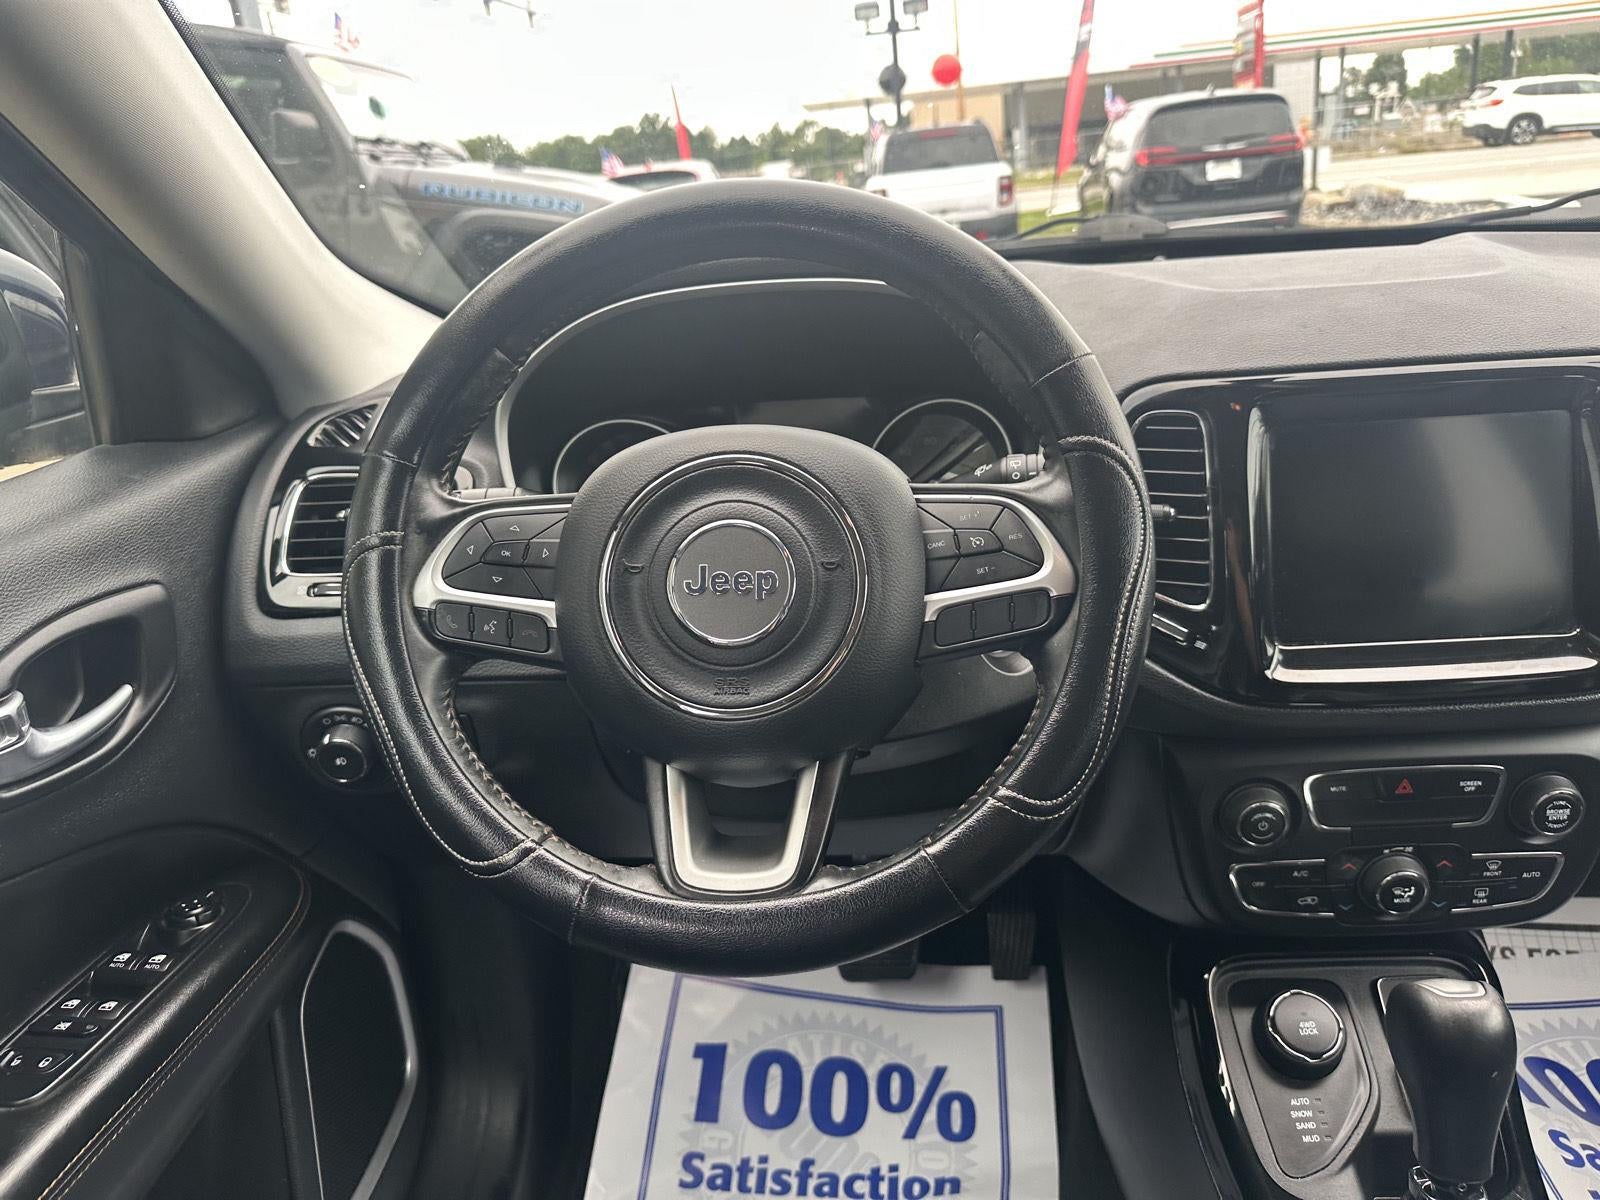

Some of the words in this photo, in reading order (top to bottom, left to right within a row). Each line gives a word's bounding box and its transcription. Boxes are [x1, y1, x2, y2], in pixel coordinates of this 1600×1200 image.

[420, 181, 584, 214] RUBICON
[1008, 533, 1023, 541] RES
[927, 540, 946, 550] CANC
[976, 566, 989, 575] SET
[683, 563, 779, 600] Jeep
[714, 677, 750, 686] SRS
[713, 687, 750, 695] AIRBAG
[1292, 870, 1309, 878] A/C
[1299, 1020, 1316, 1029] 4WD
[1299, 1027, 1319, 1036] LOCK
[691, 1042, 976, 1143] 100%
[1290, 1098, 1309, 1106] AUTO
[1290, 1110, 1313, 1118] SNOW
[1295, 1122, 1317, 1130] SAND
[1302, 1134, 1320, 1143] MUD
[678, 1150, 961, 1200] Satisfaction
